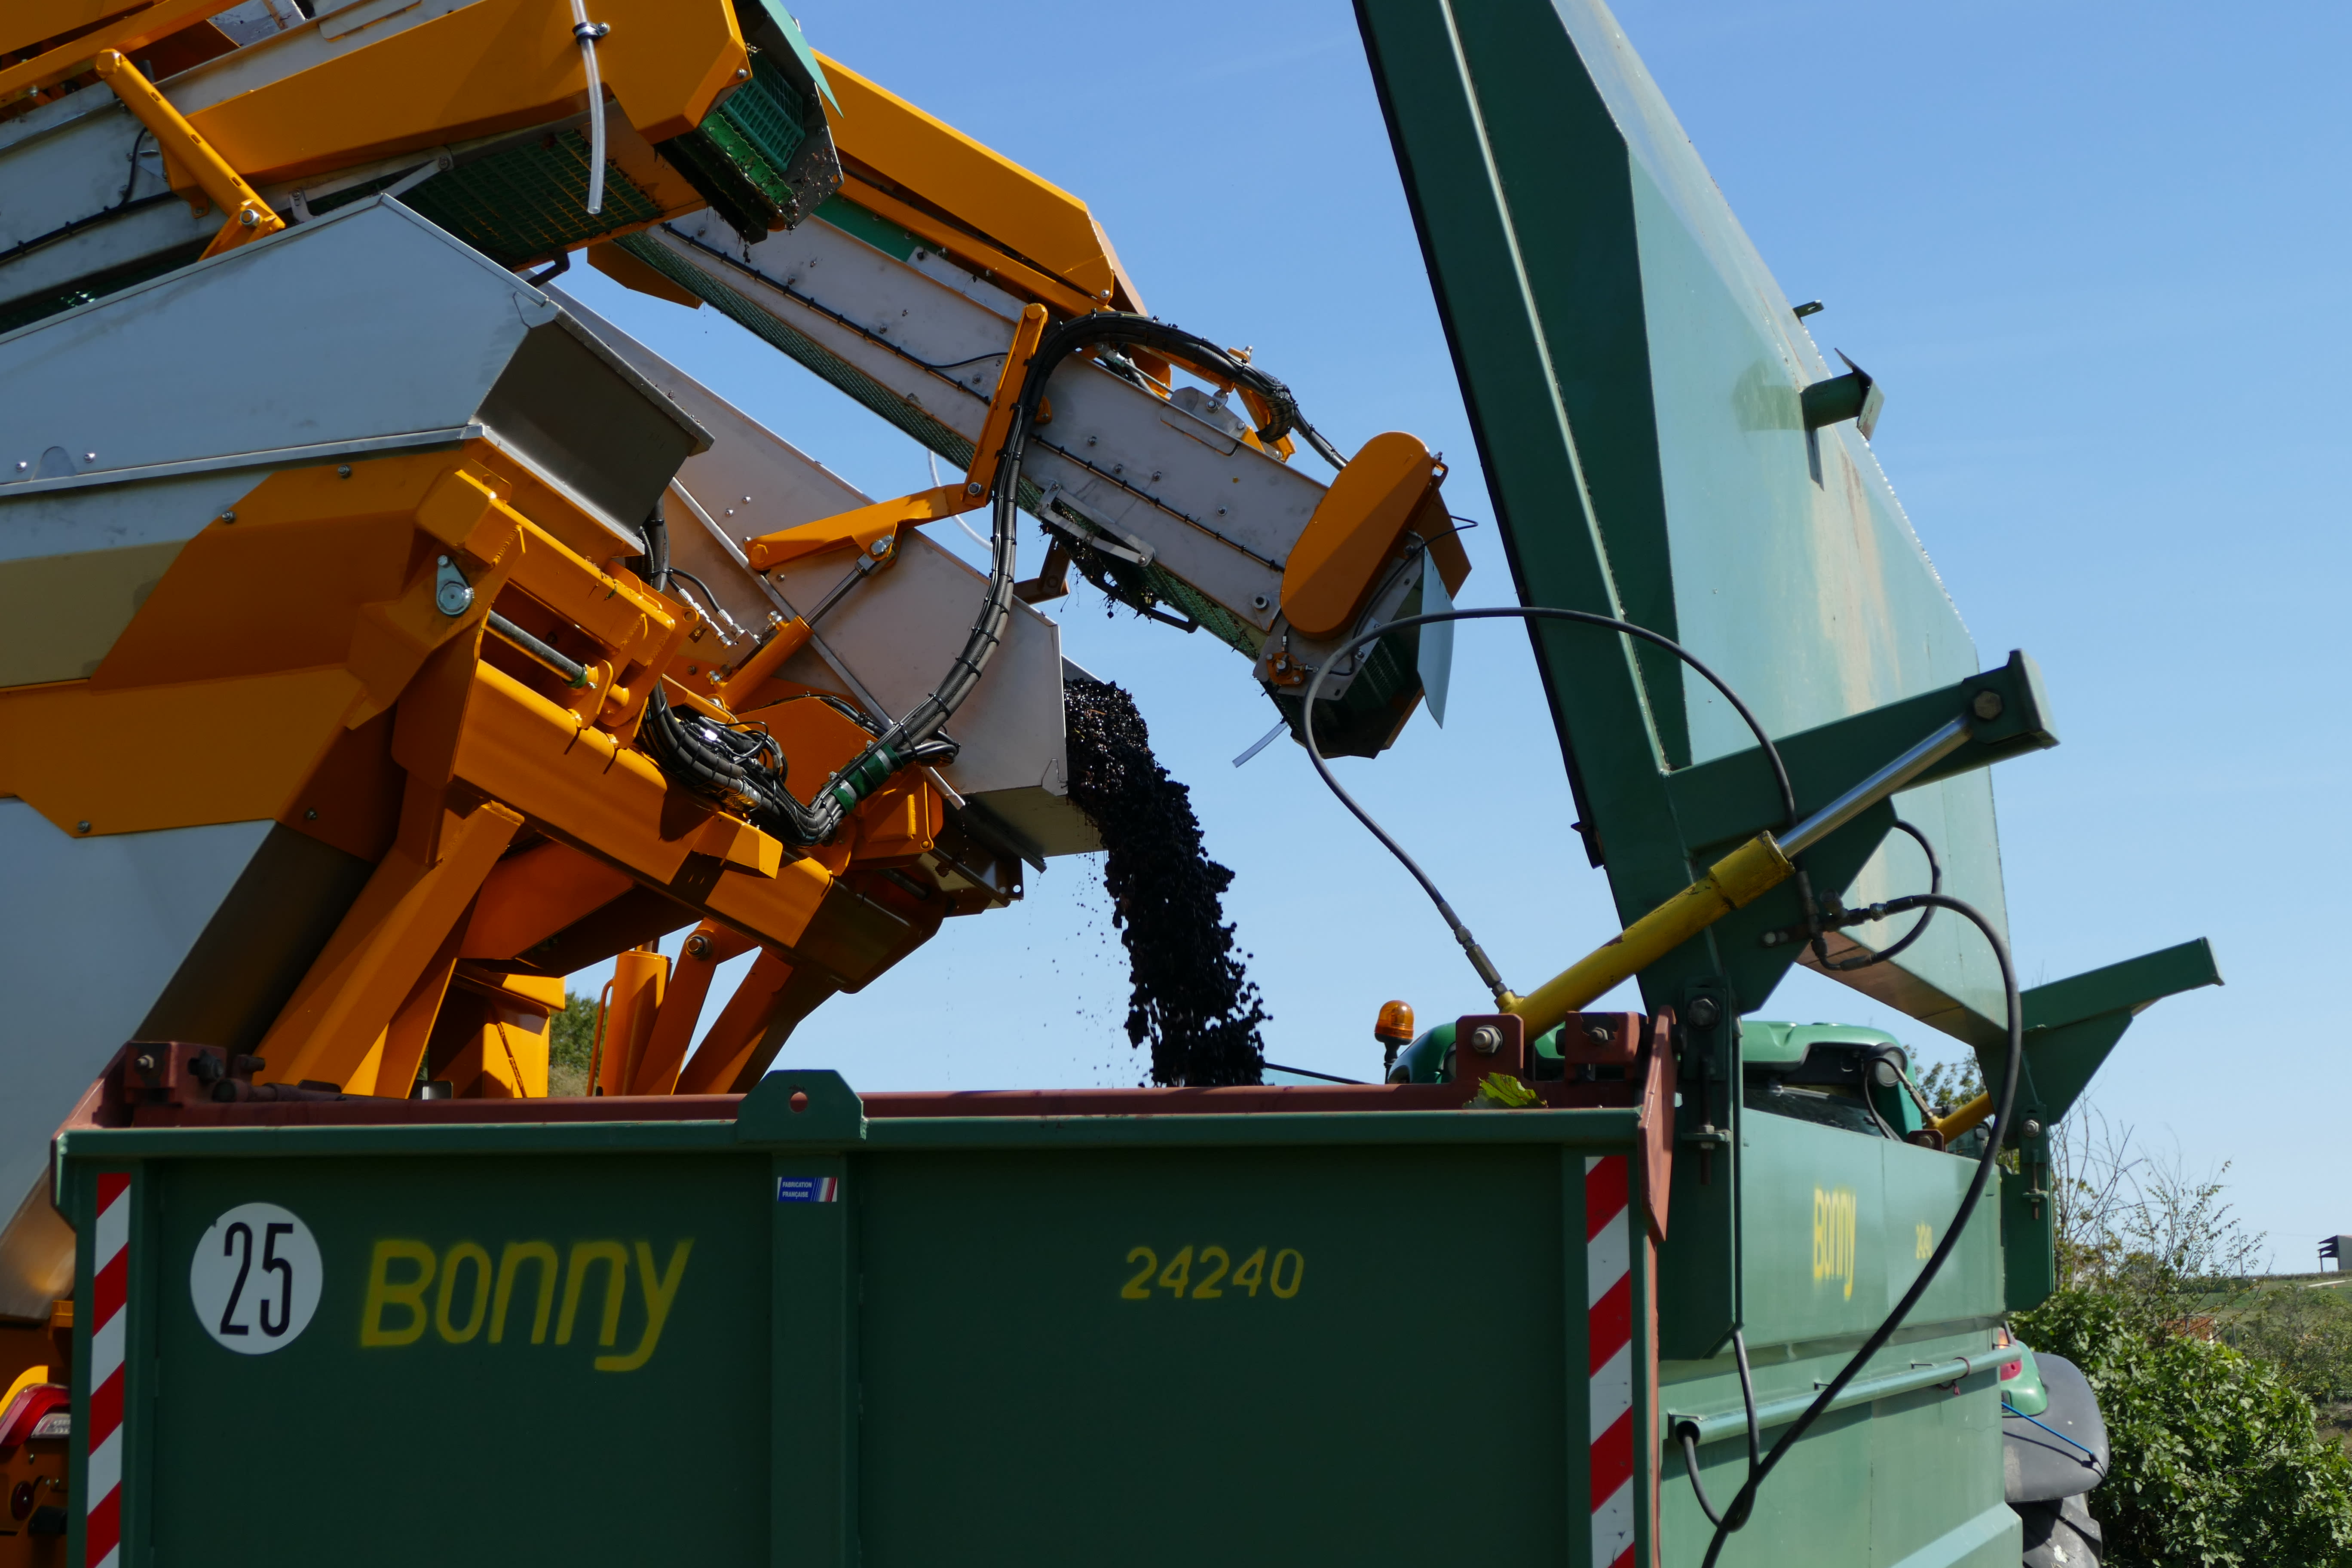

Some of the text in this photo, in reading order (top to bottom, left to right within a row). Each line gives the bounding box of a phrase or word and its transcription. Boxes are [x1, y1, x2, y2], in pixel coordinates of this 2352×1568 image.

[782, 1191, 808, 1199] FRANÇAISE
[220, 1222, 293, 1337] 25
[360, 1238, 695, 1372] Bonny
[1121, 1245, 1305, 1300] 24240
